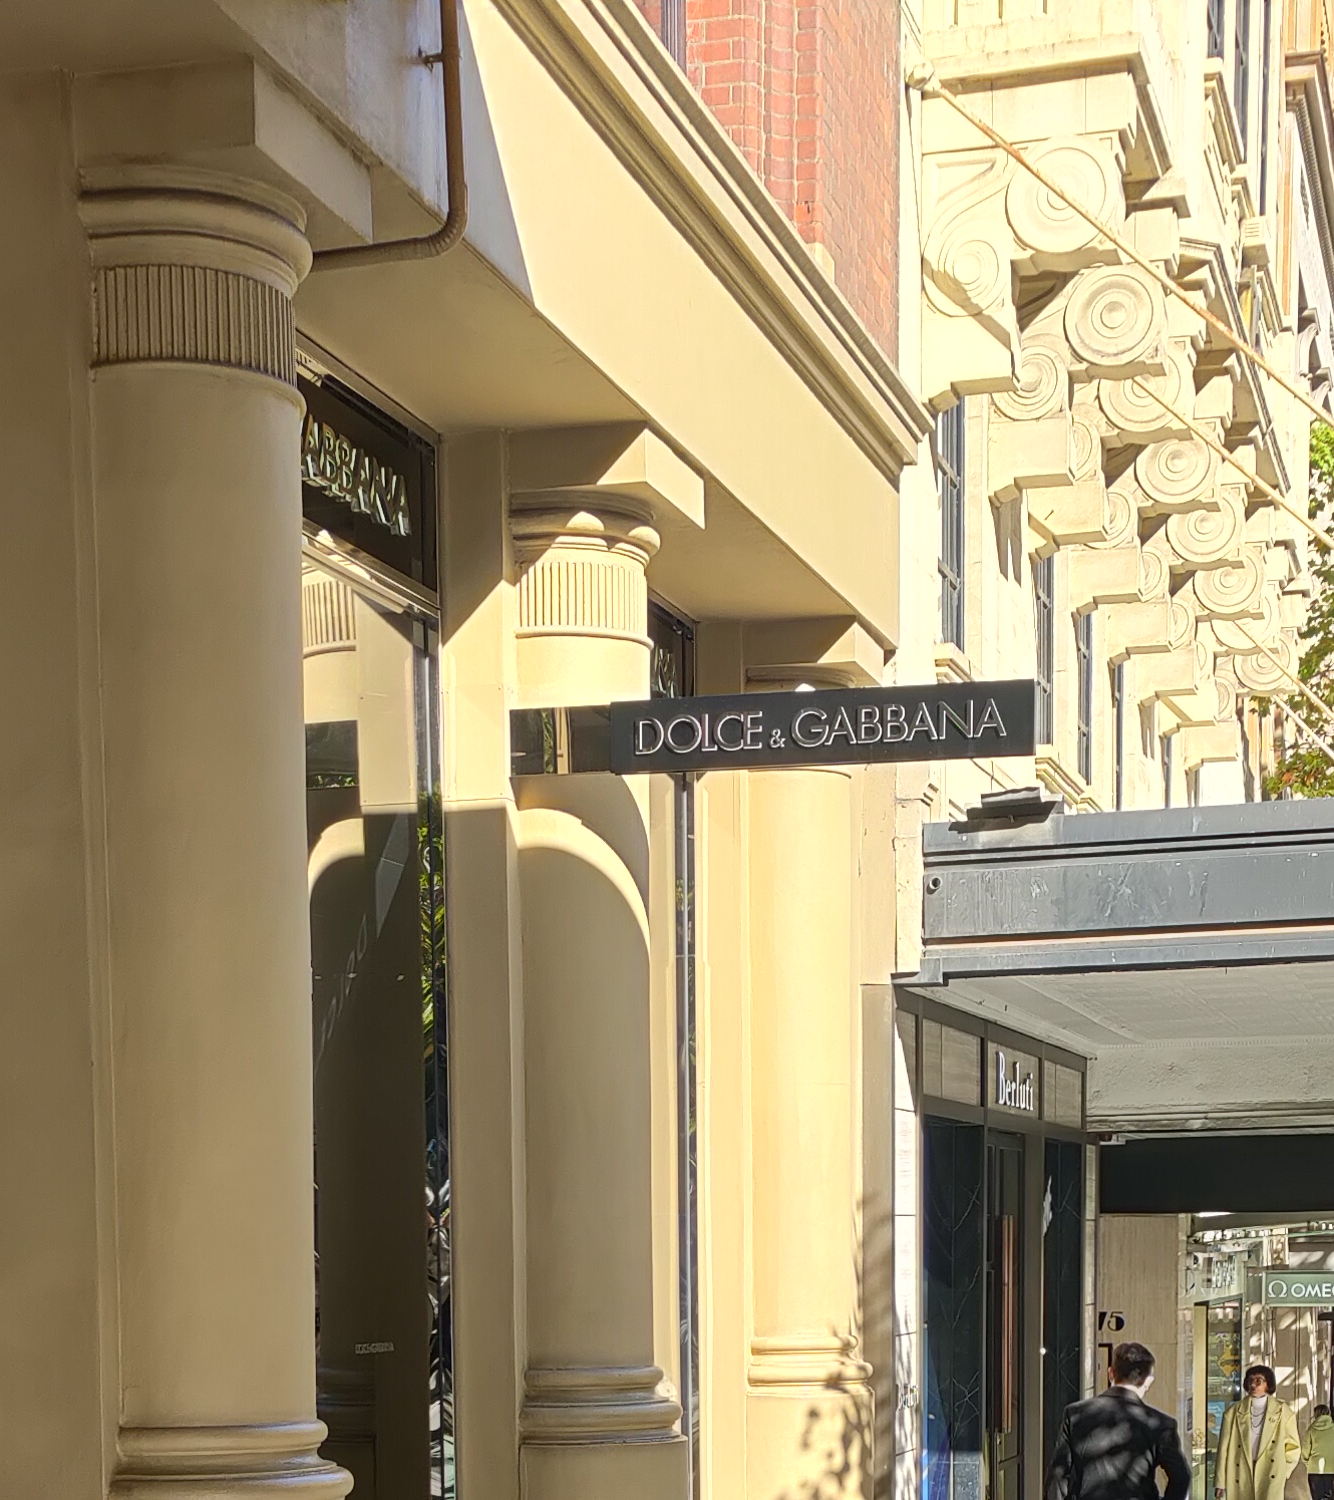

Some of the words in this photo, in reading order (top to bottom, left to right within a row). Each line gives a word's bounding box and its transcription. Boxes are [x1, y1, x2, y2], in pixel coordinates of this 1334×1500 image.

[301, 414, 413, 537] ABBANA
[632, 710, 763, 756] DOLCE
[769, 728, 786, 749] &
[790, 698, 1007, 749] GABBANA
[998, 1051, 1034, 1111] Berluti
